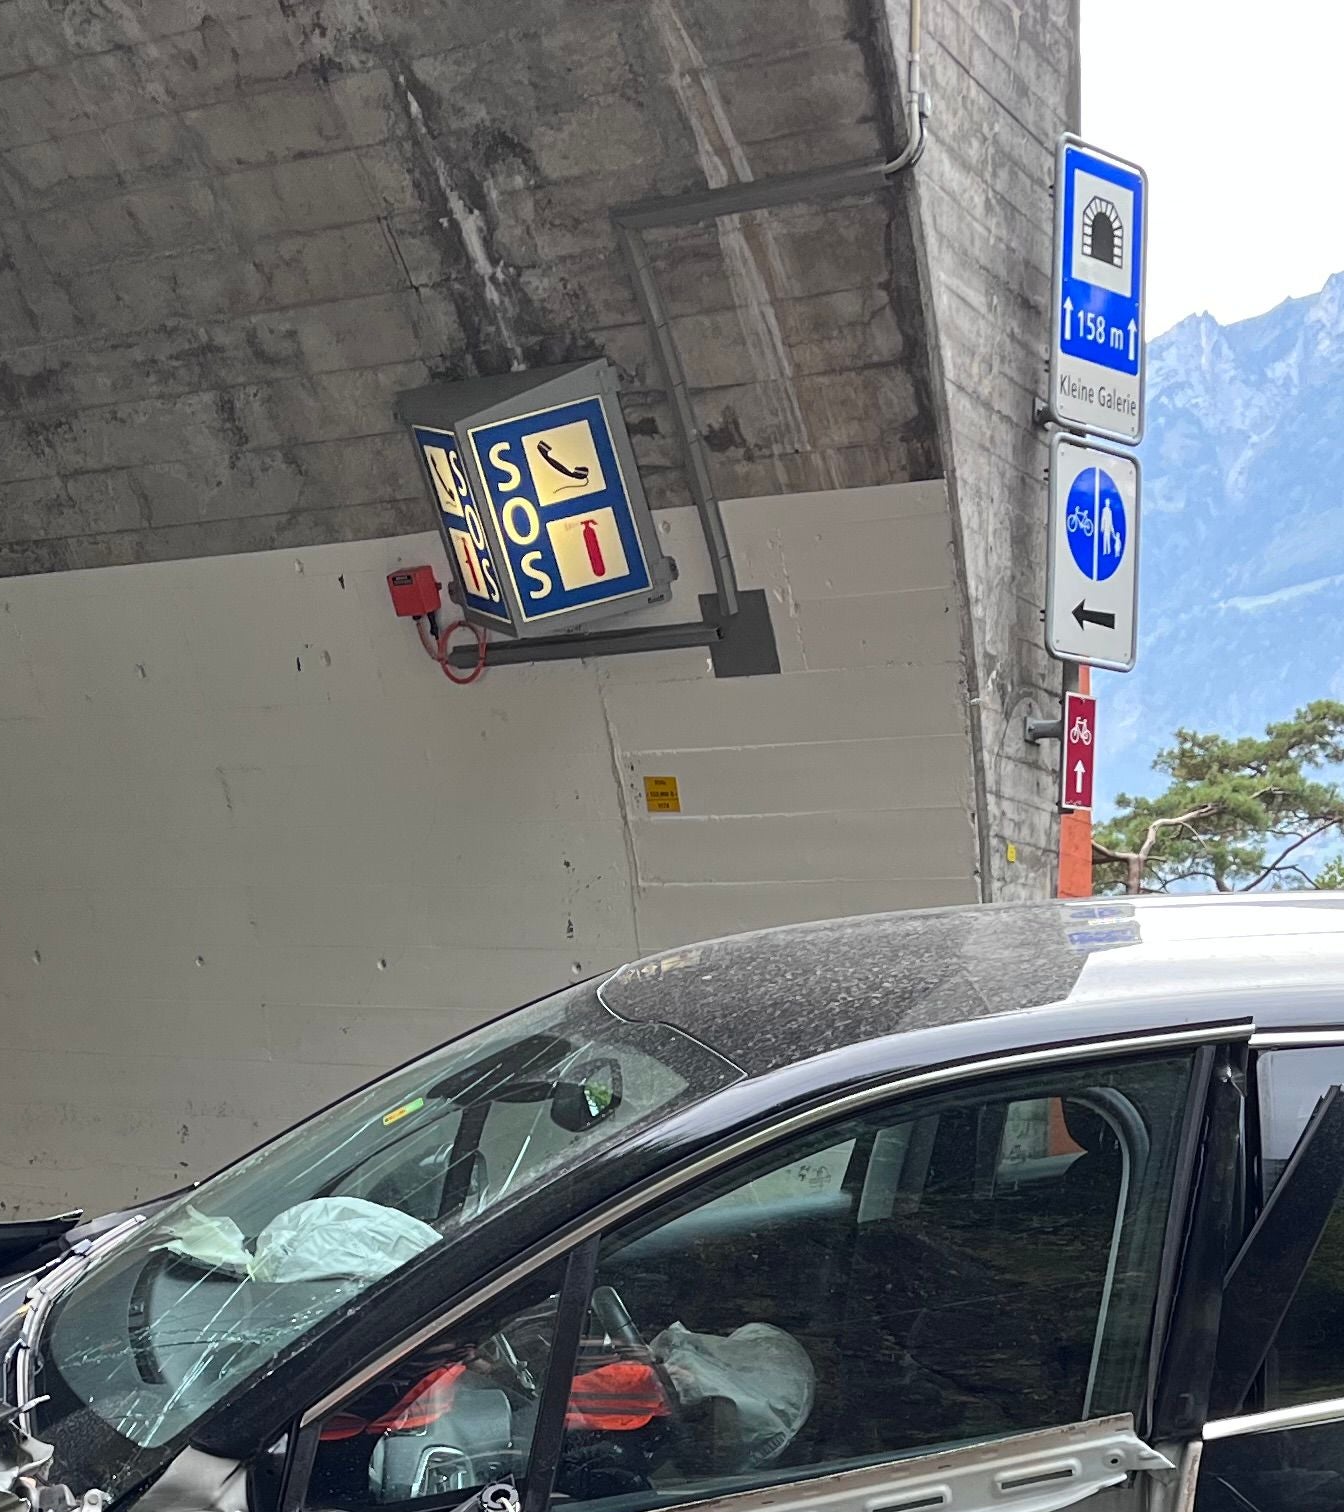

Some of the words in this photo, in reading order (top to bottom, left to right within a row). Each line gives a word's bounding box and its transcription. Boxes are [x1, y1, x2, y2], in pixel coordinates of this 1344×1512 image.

[1078, 310, 1106, 344] 158
[1110, 326, 1124, 351] m
[1060, 374, 1095, 403] Kleine
[1098, 386, 1137, 416] Galerie
[449, 450, 500, 603] SOS
[489, 441, 553, 600] SOS
